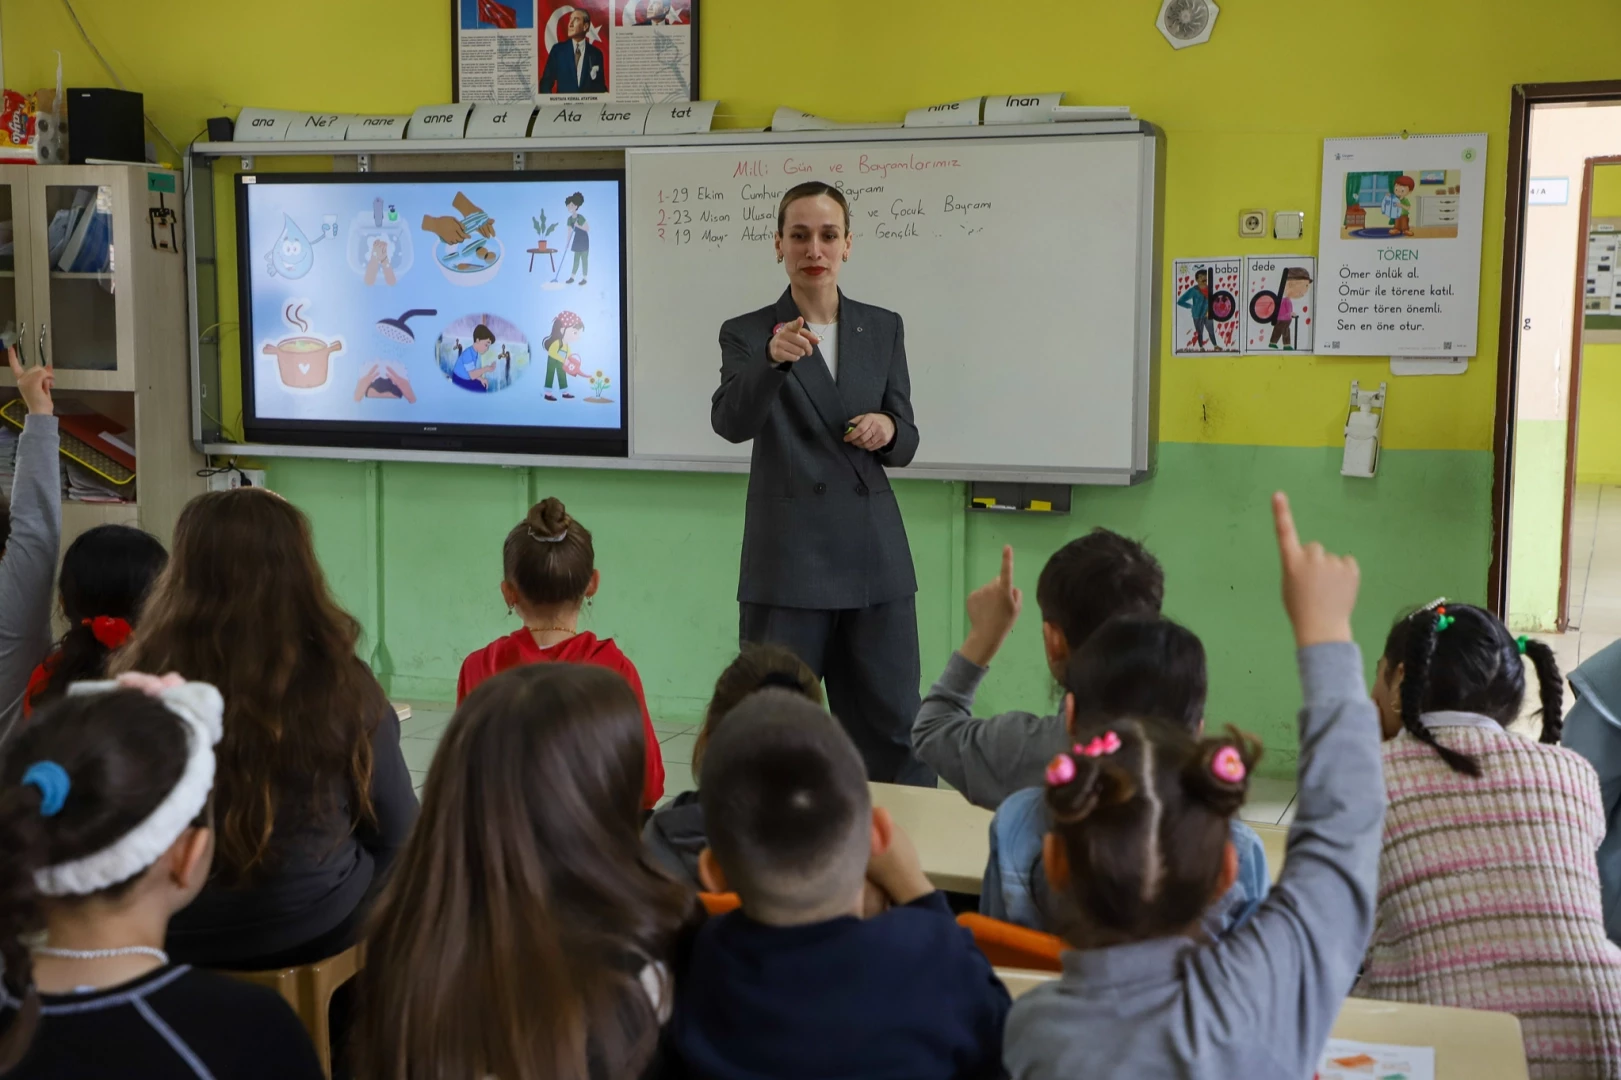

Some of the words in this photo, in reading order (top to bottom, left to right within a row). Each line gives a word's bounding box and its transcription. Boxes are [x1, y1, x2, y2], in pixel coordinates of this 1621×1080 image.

[671, 107, 692, 118] tat
[928, 103, 960, 112] nine
[305, 115, 338, 128] Ne?
[363, 117, 395, 126] nane
[423, 113, 453, 124] anne
[493, 111, 507, 123] at
[553, 109, 582, 122] Ata
[601, 110, 631, 121] tane
[252, 117, 275, 127] ana
[733, 160, 769, 178] Milli
[783, 158, 813, 175] Gün
[829, 163, 844, 173] ve
[859, 154, 961, 179] Bayramlarımız
[697, 186, 724, 200] Ekim
[700, 210, 731, 222] Nisan
[743, 204, 776, 221] Ulusal
[867, 209, 879, 217] ve
[890, 198, 926, 220] Çocuk
[944, 194, 992, 215] Bayramı
[675, 228, 691, 245] 19
[875, 222, 919, 239] Gençlik
[1377, 246, 1418, 261] TÖREN
[1215, 264, 1238, 274] baba
[1252, 261, 1275, 271] dede
[1339, 264, 1371, 278] Ömer
[1375, 267, 1402, 278] önlük
[1407, 267, 1419, 278] al.
[1338, 281, 1370, 296] Ömür
[1375, 284, 1387, 296] ile
[1391, 286, 1425, 296] törene
[1430, 284, 1454, 296] katıl.
[1338, 298, 1369, 313] Ömer
[1374, 304, 1402, 313] tören
[1406, 302, 1442, 313] önemli.
[1337, 319, 1356, 331] Sen
[1360, 323, 1372, 331] en
[1376, 322, 1395, 331] öne
[1399, 321, 1424, 331] otur.
